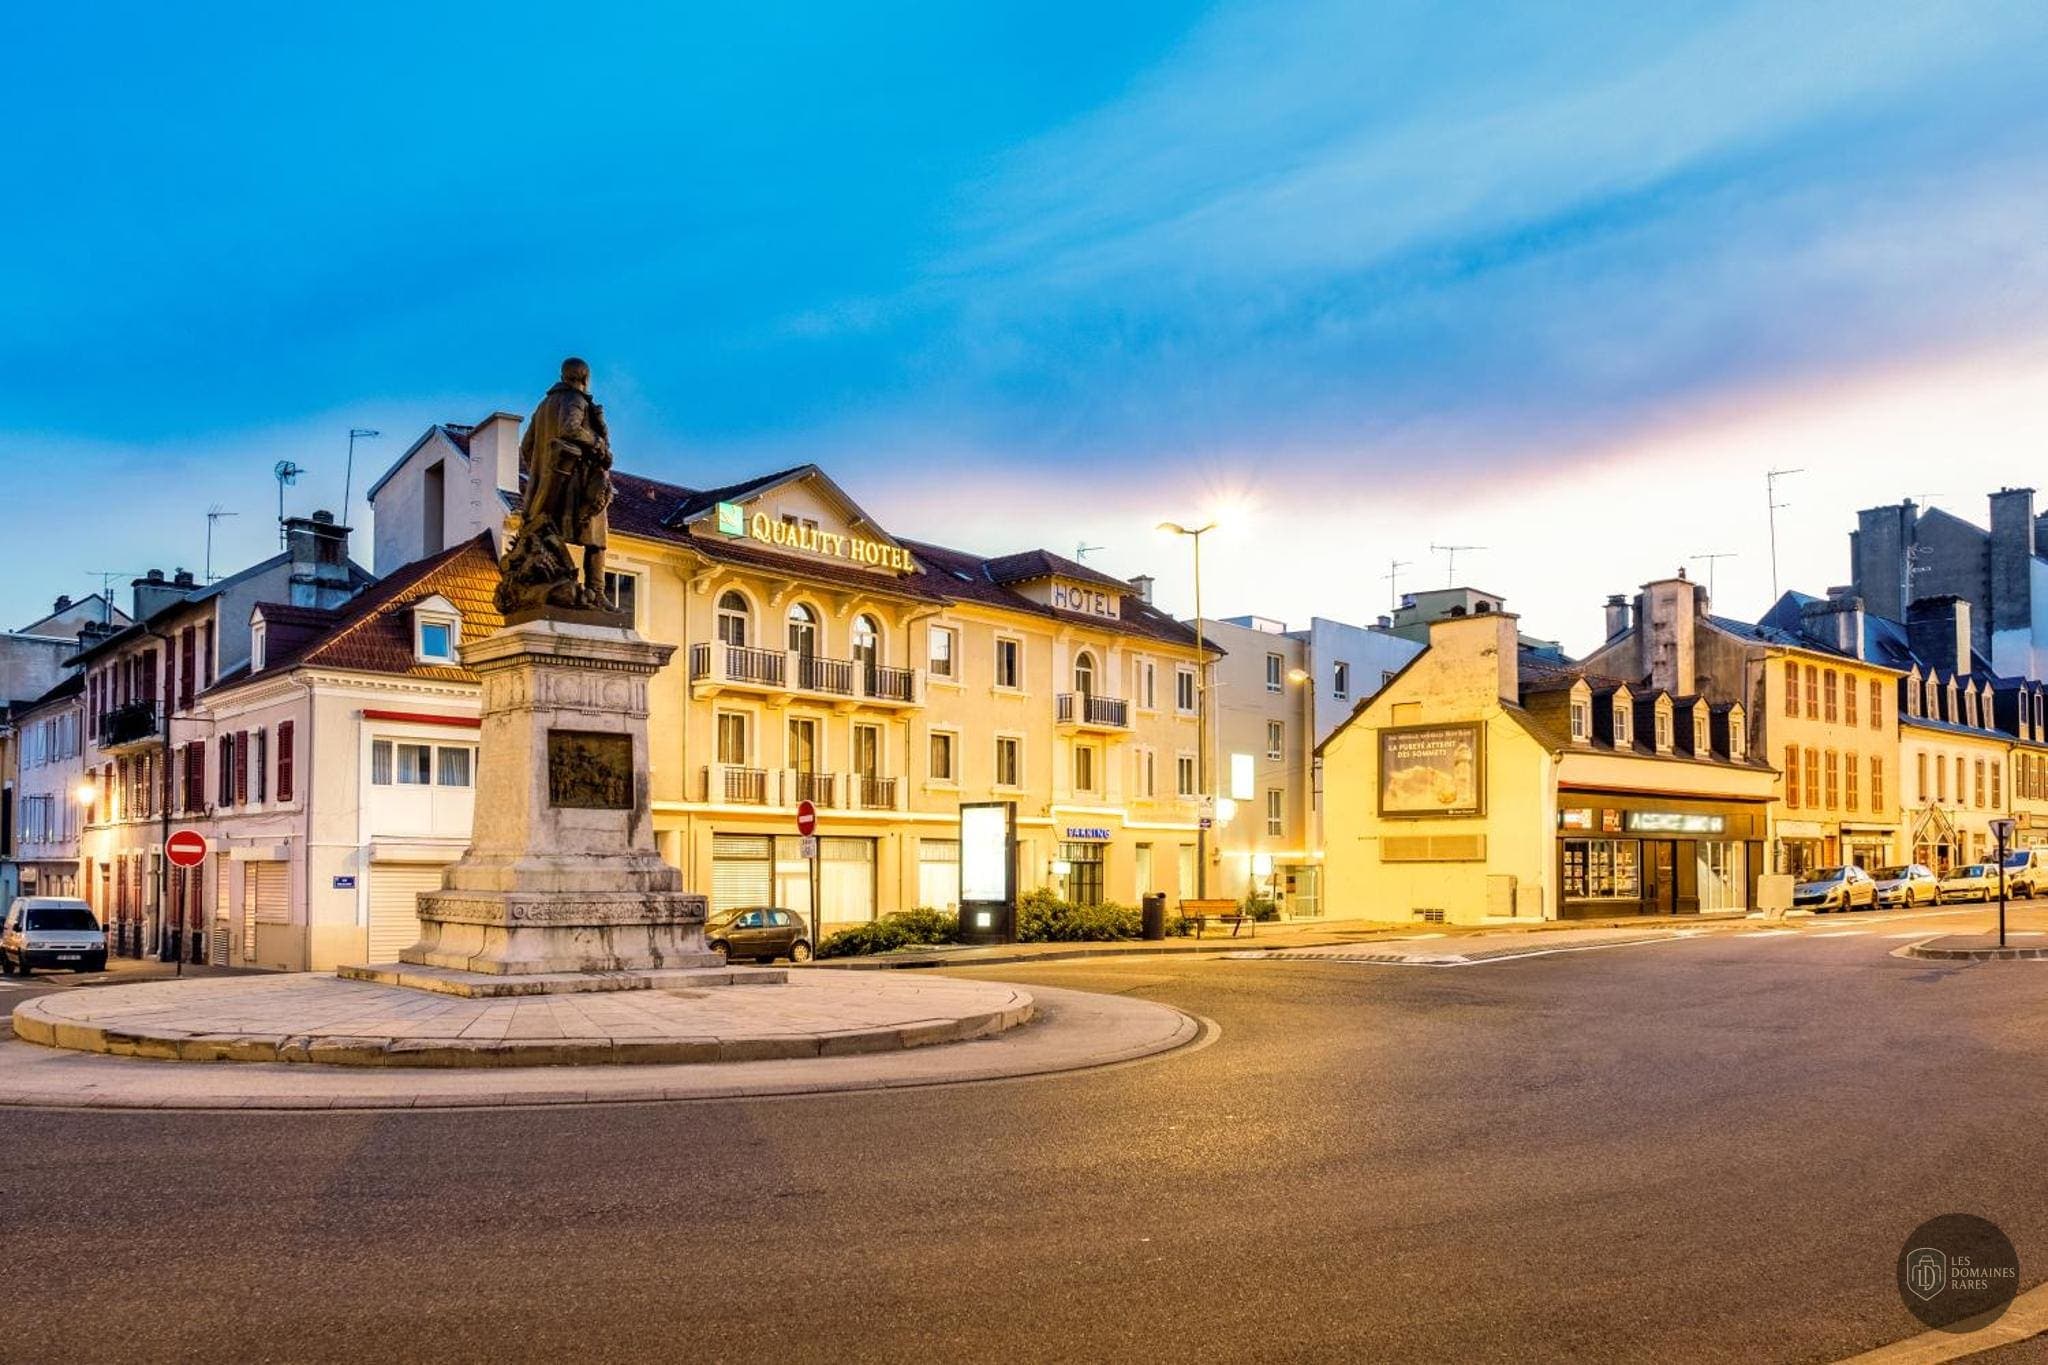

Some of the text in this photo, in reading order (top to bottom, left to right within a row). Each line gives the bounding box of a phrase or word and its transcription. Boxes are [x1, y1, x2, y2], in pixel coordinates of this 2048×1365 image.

[752, 512, 914, 571] QUALITY HOTEL
[1054, 583, 1116, 617] HOTEL
